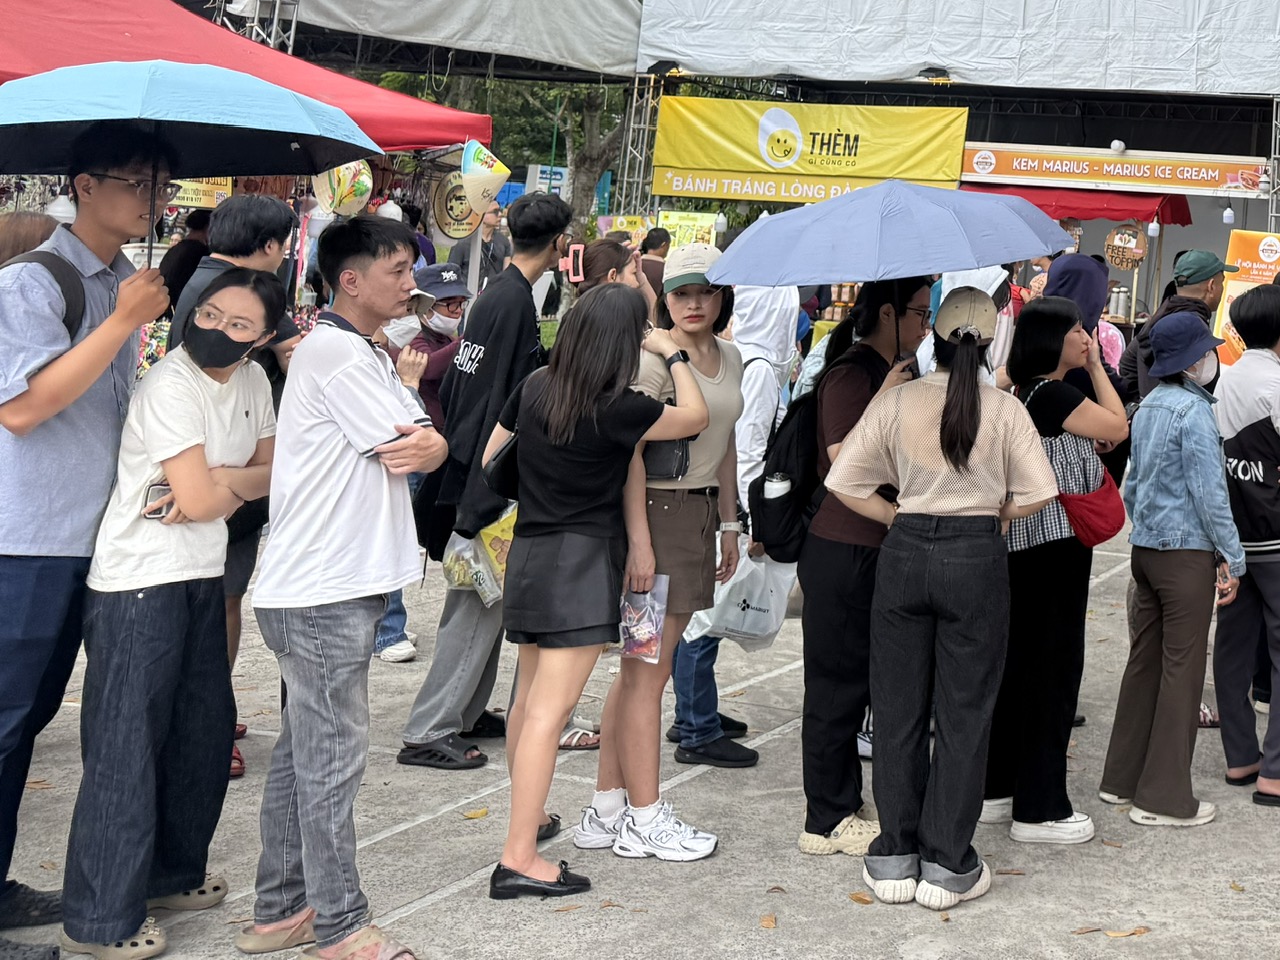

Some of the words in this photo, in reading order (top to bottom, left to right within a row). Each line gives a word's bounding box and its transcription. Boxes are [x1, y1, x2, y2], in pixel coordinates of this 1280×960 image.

[809, 128, 860, 157] THÈM
[1012, 157, 1039, 171] KEM
[1042, 159, 1089, 174] MARIUS
[1103, 162, 1151, 178] MARIUS
[1154, 166, 1172, 179] ICE
[1175, 166, 1219, 181] CREAM
[672, 176, 717, 193] BÁNH
[721, 177, 776, 196] TRÁNG
[780, 179, 826, 198] LÒNG
[830, 183, 863, 199] ĐÀ
[1105, 244, 1127, 256] FREE
